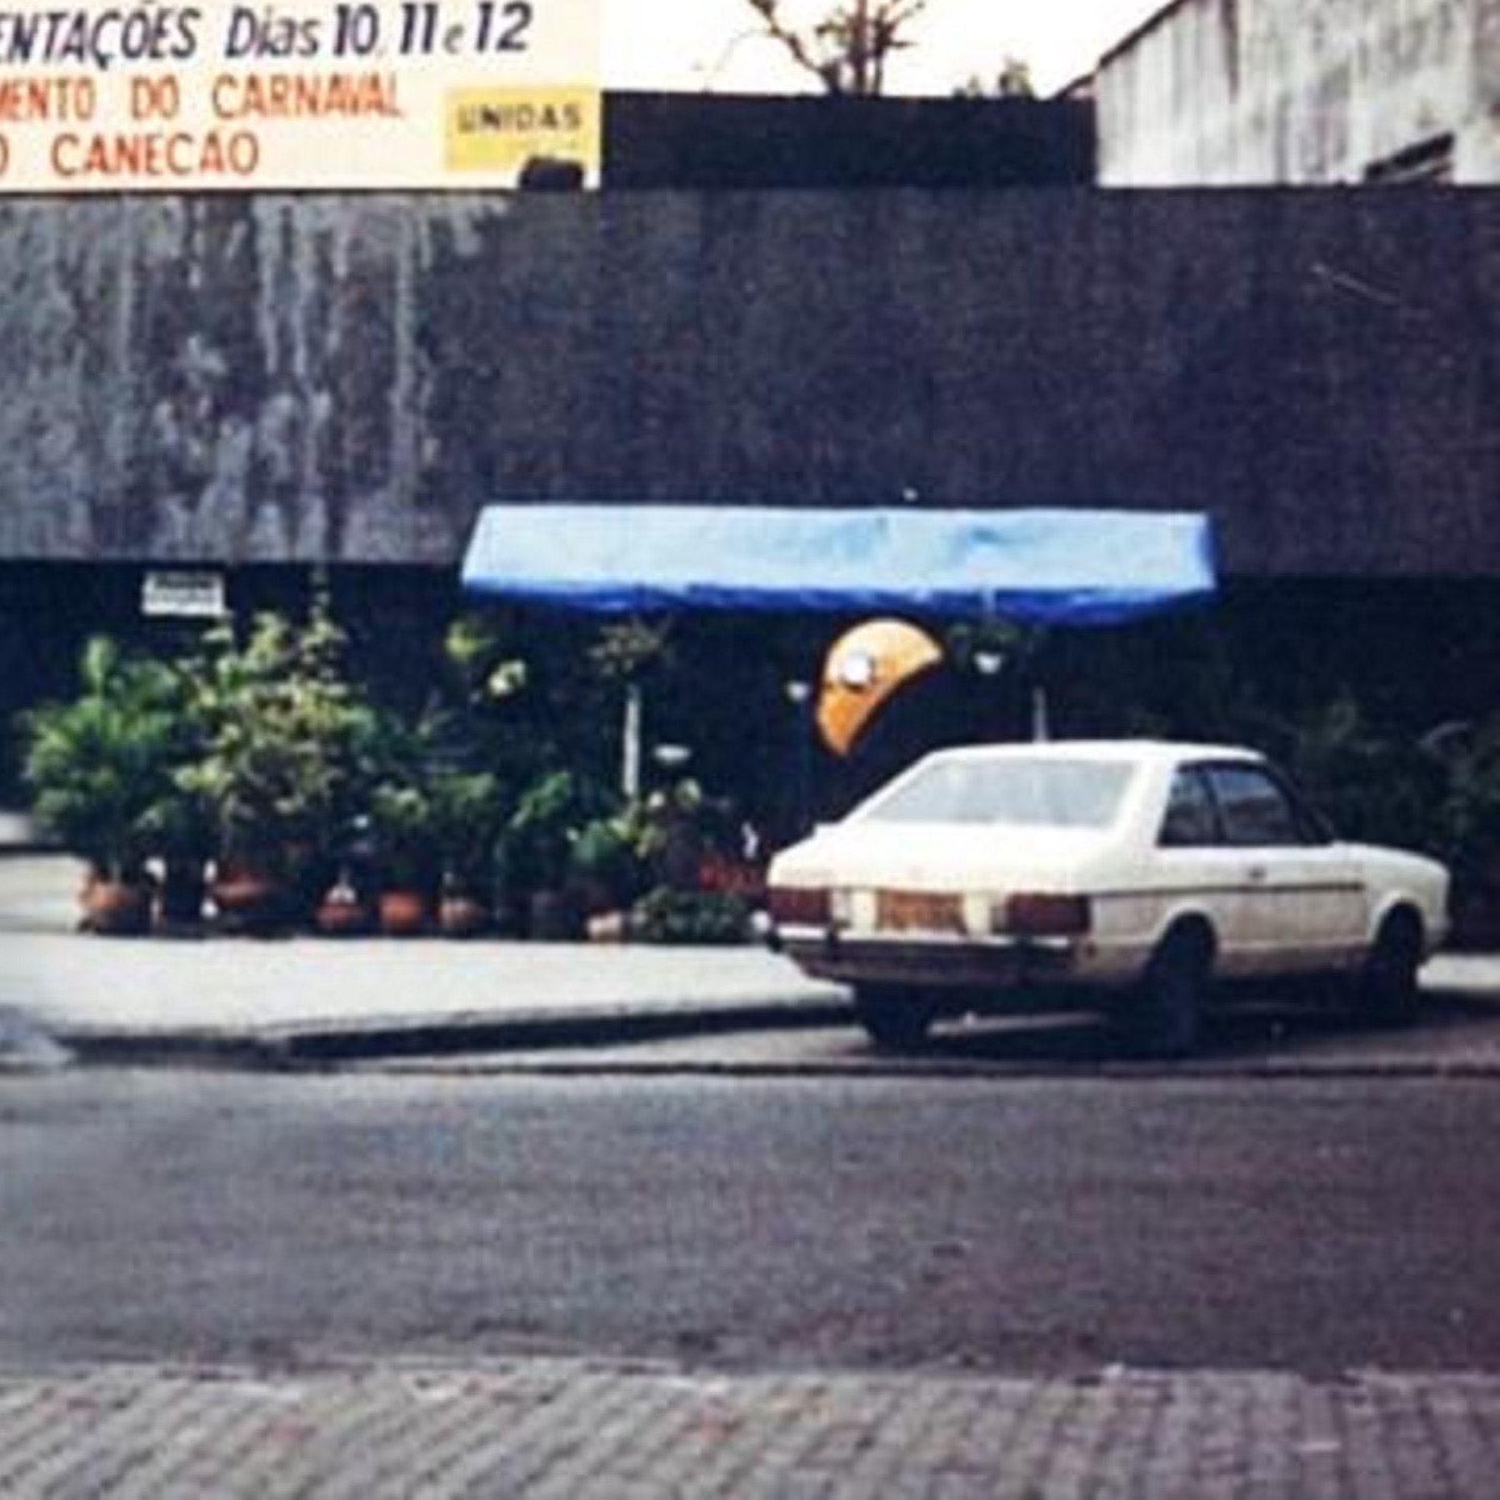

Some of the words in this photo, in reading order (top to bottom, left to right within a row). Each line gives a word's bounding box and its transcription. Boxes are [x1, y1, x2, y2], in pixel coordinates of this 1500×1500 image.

[225, 7, 321, 60] Dias
[399, 3, 440, 55] 11
[474, 2, 534, 53] 12
[131, 76, 181, 121] DO
[211, 73, 403, 118] CARNAVAL
[457, 104, 581, 133] UNIDAS
